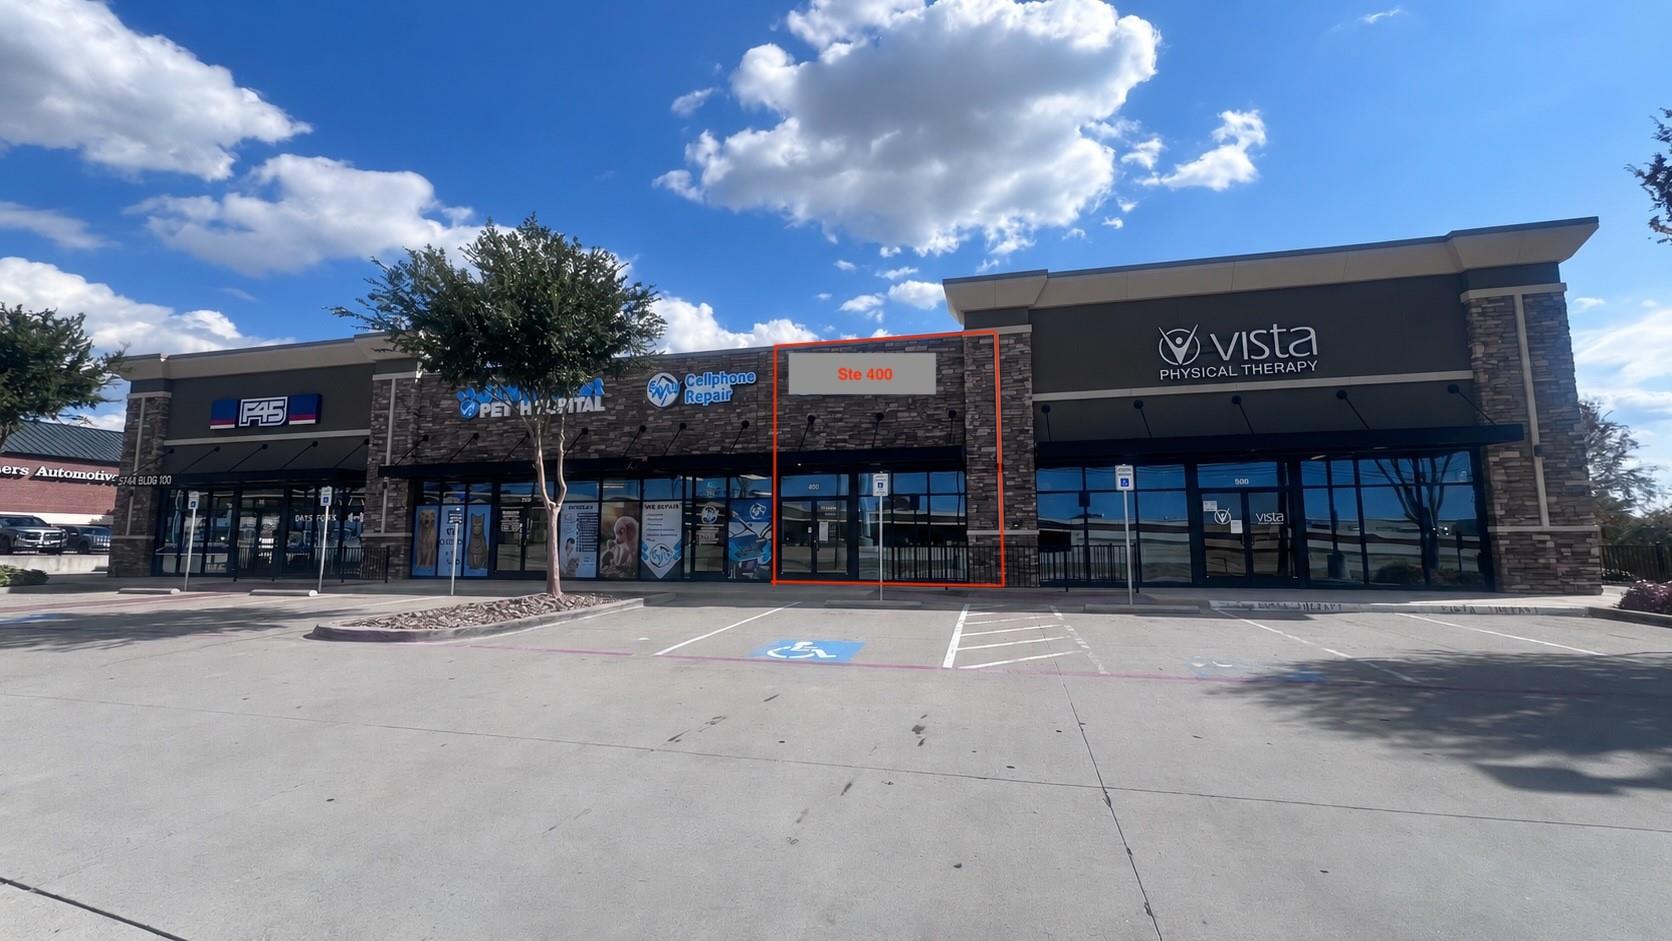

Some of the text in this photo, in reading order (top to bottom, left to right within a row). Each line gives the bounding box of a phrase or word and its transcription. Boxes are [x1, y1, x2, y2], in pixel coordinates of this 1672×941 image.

[1209, 323, 1318, 361] vista
[1160, 360, 1318, 381] PHYSICAL THERAPY
[685, 371, 756, 389] Cellphone
[479, 394, 605, 418] PET HSPITAL
[685, 388, 733, 406] Repair
[240, 397, 288, 426] F45
[0, 465, 30, 475] ers
[138, 475, 158, 485] BLDG
[160, 475, 172, 484] 100
[1256, 512, 1284, 522] vista
